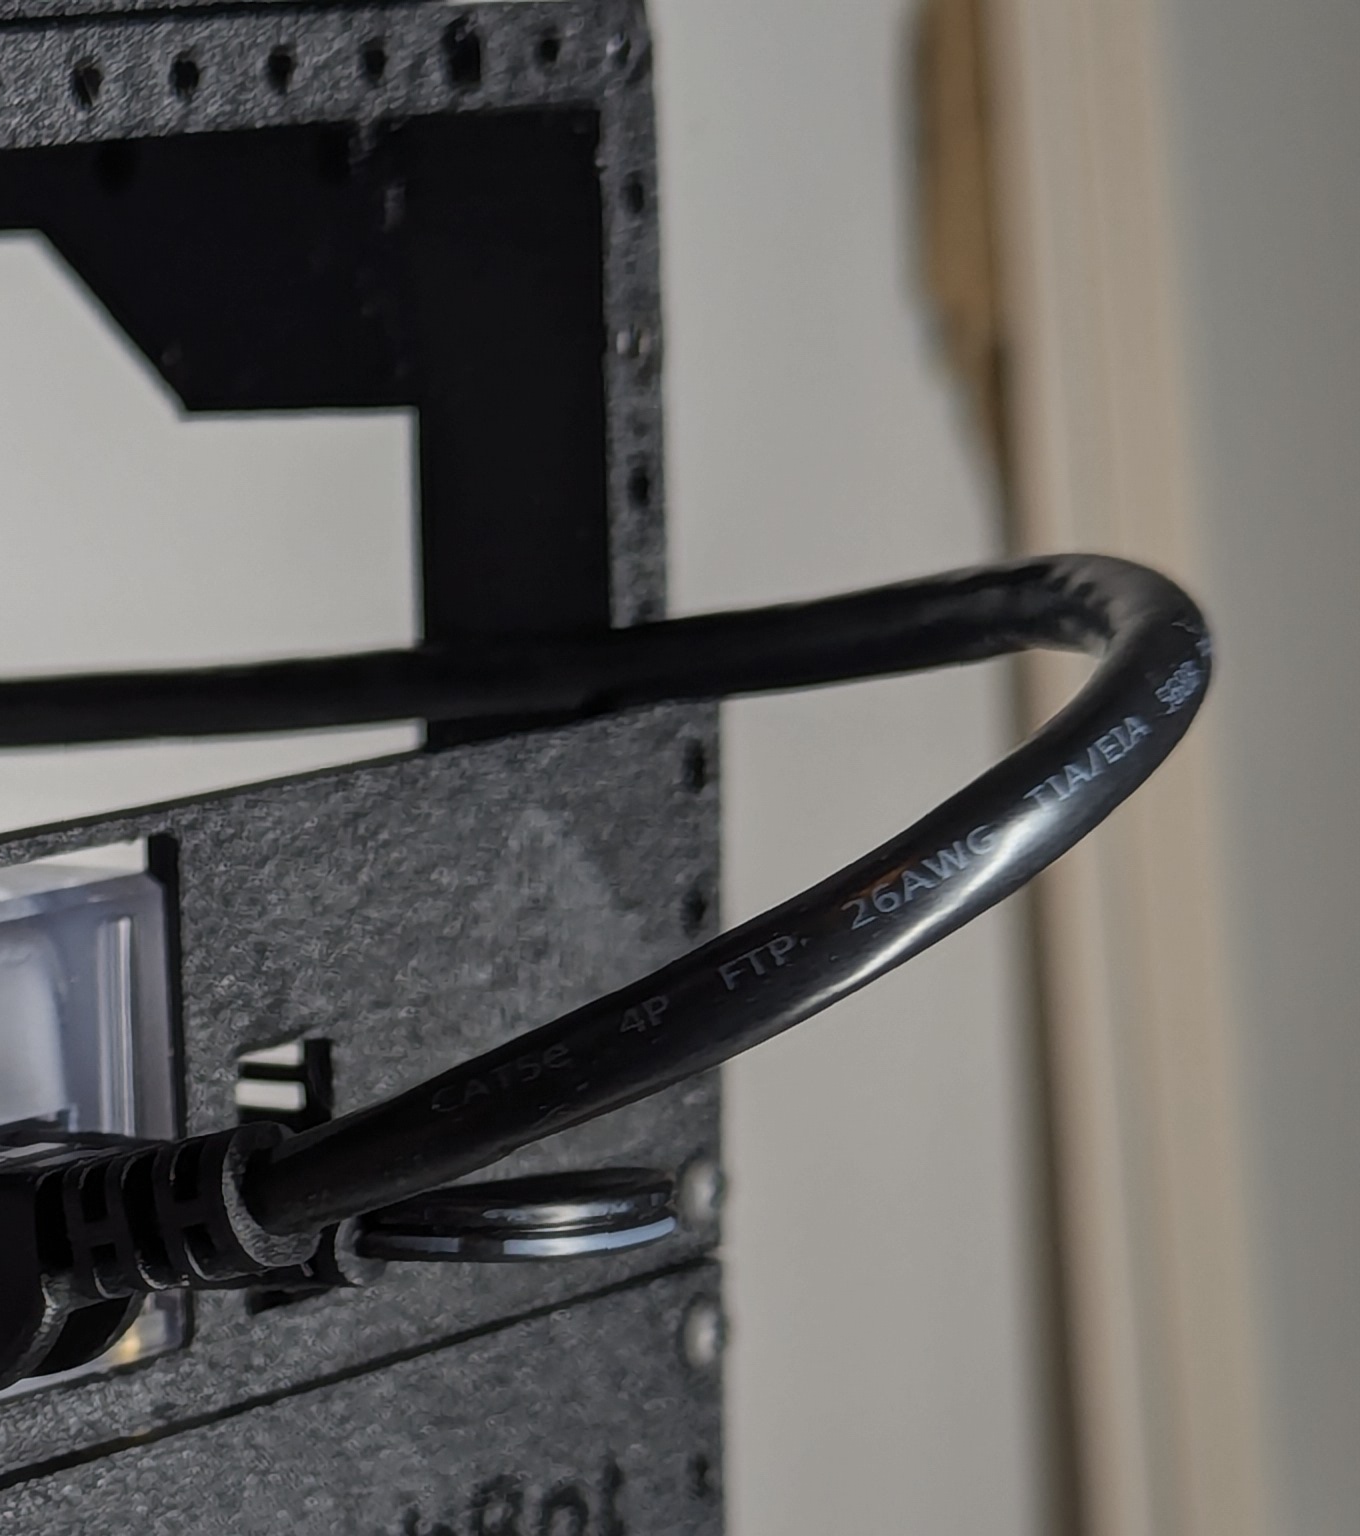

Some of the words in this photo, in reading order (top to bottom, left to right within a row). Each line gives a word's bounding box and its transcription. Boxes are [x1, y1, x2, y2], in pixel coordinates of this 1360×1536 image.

[431, 1043, 572, 1112] CAT5e
[620, 995, 669, 1033] 4P
[717, 934, 797, 991] FTP
[841, 824, 997, 930] 26AWG
[1023, 716, 1153, 809] TIA/EIA
